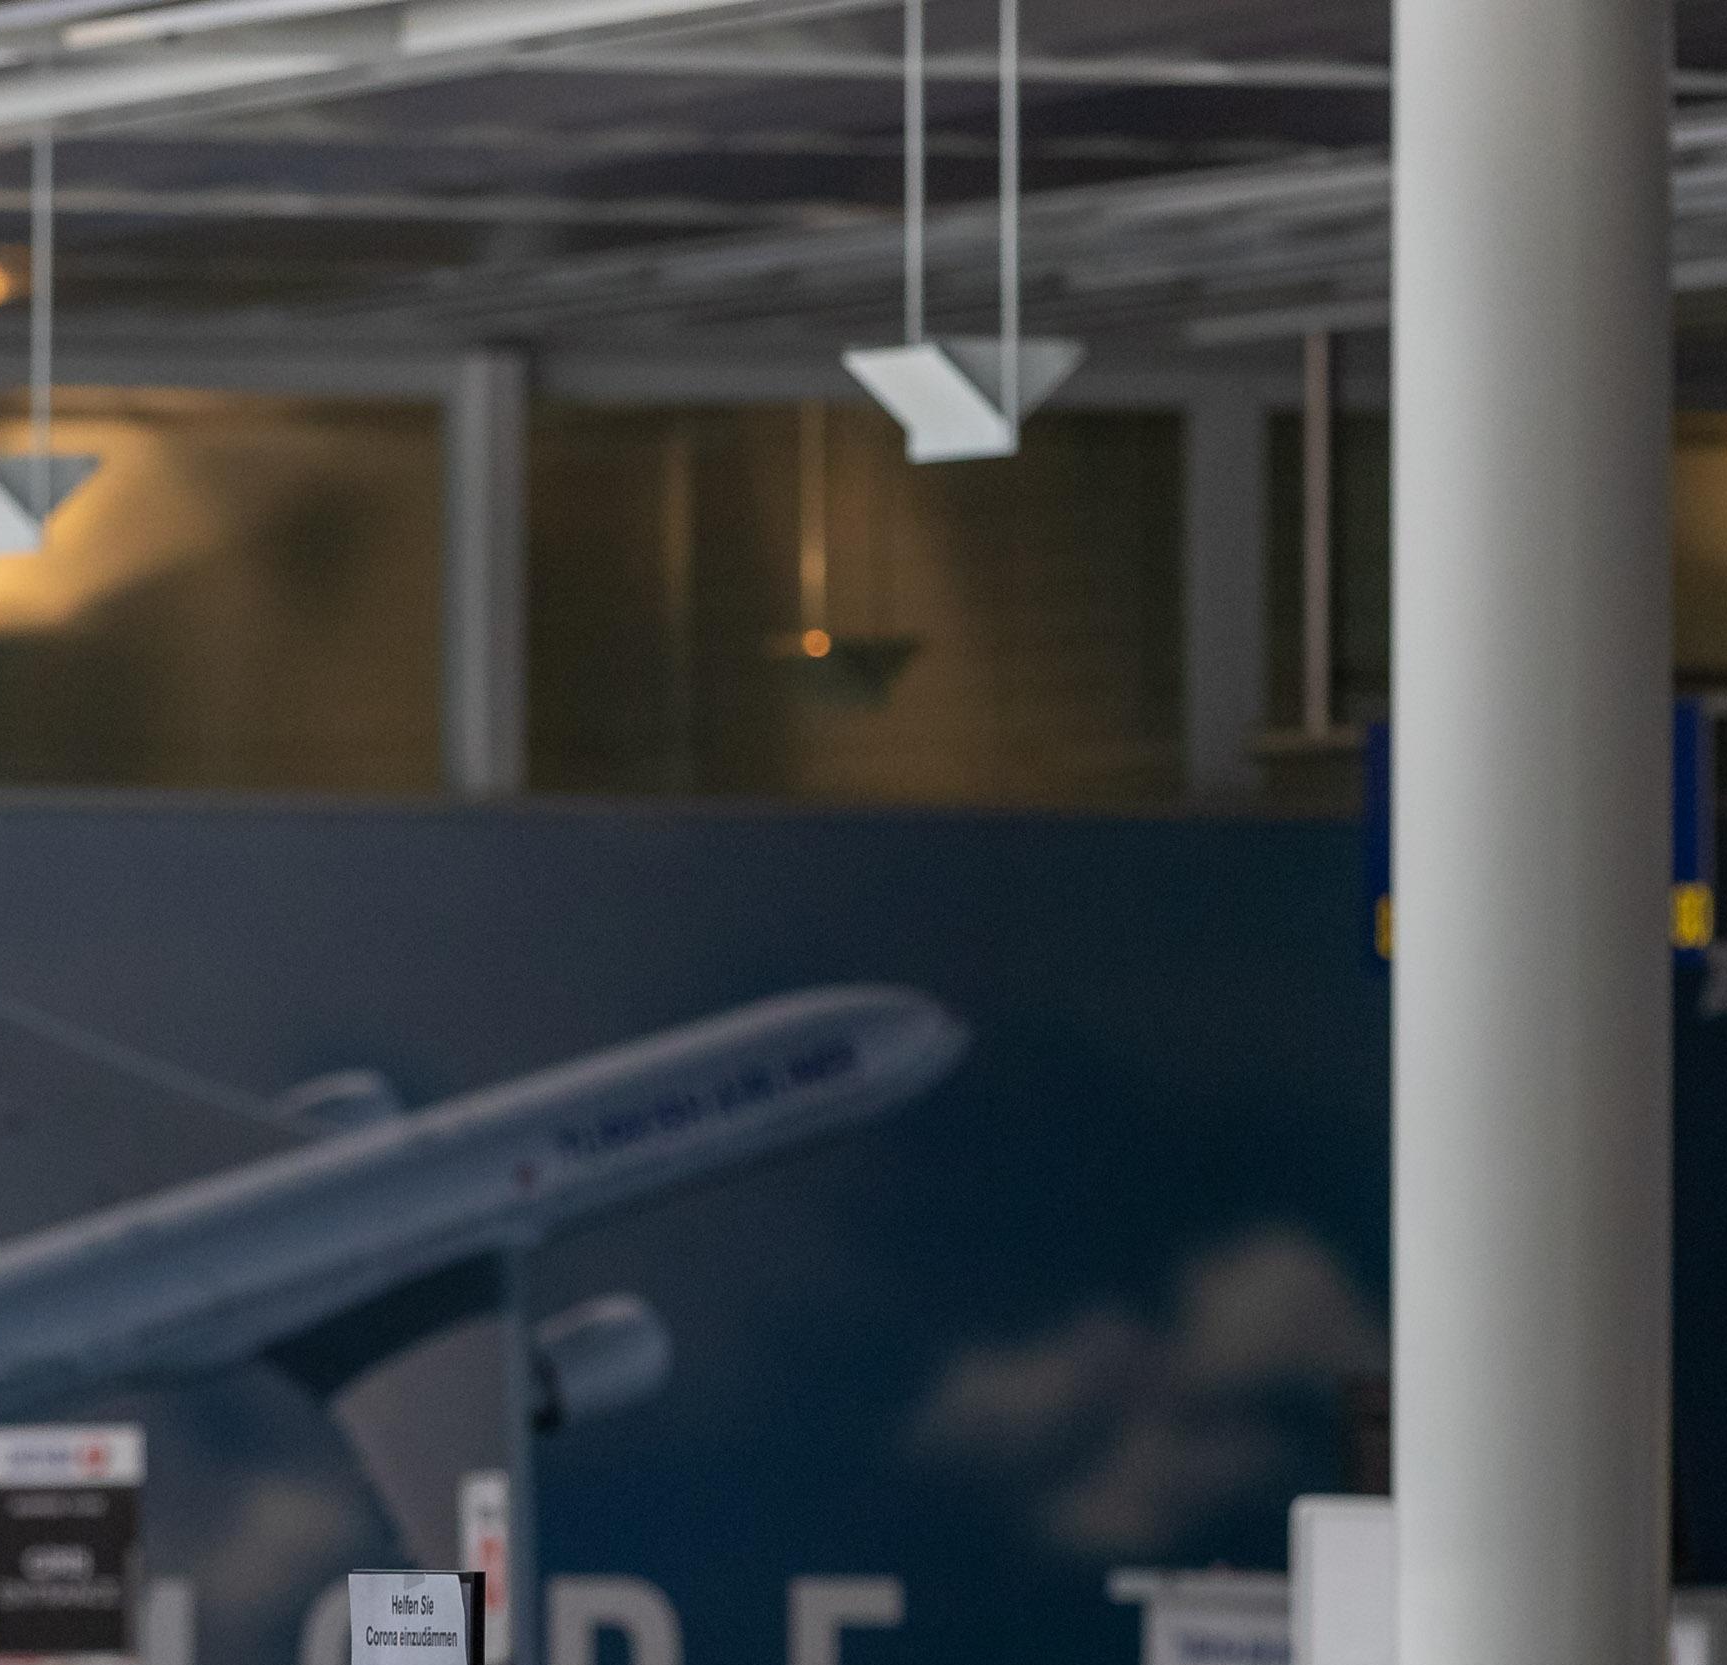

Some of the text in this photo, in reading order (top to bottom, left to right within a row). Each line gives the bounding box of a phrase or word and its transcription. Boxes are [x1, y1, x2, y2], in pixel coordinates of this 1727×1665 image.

[392, 1595, 434, 1615] Helfen Sie
[366, 1626, 458, 1647] Corona einzudämmen
